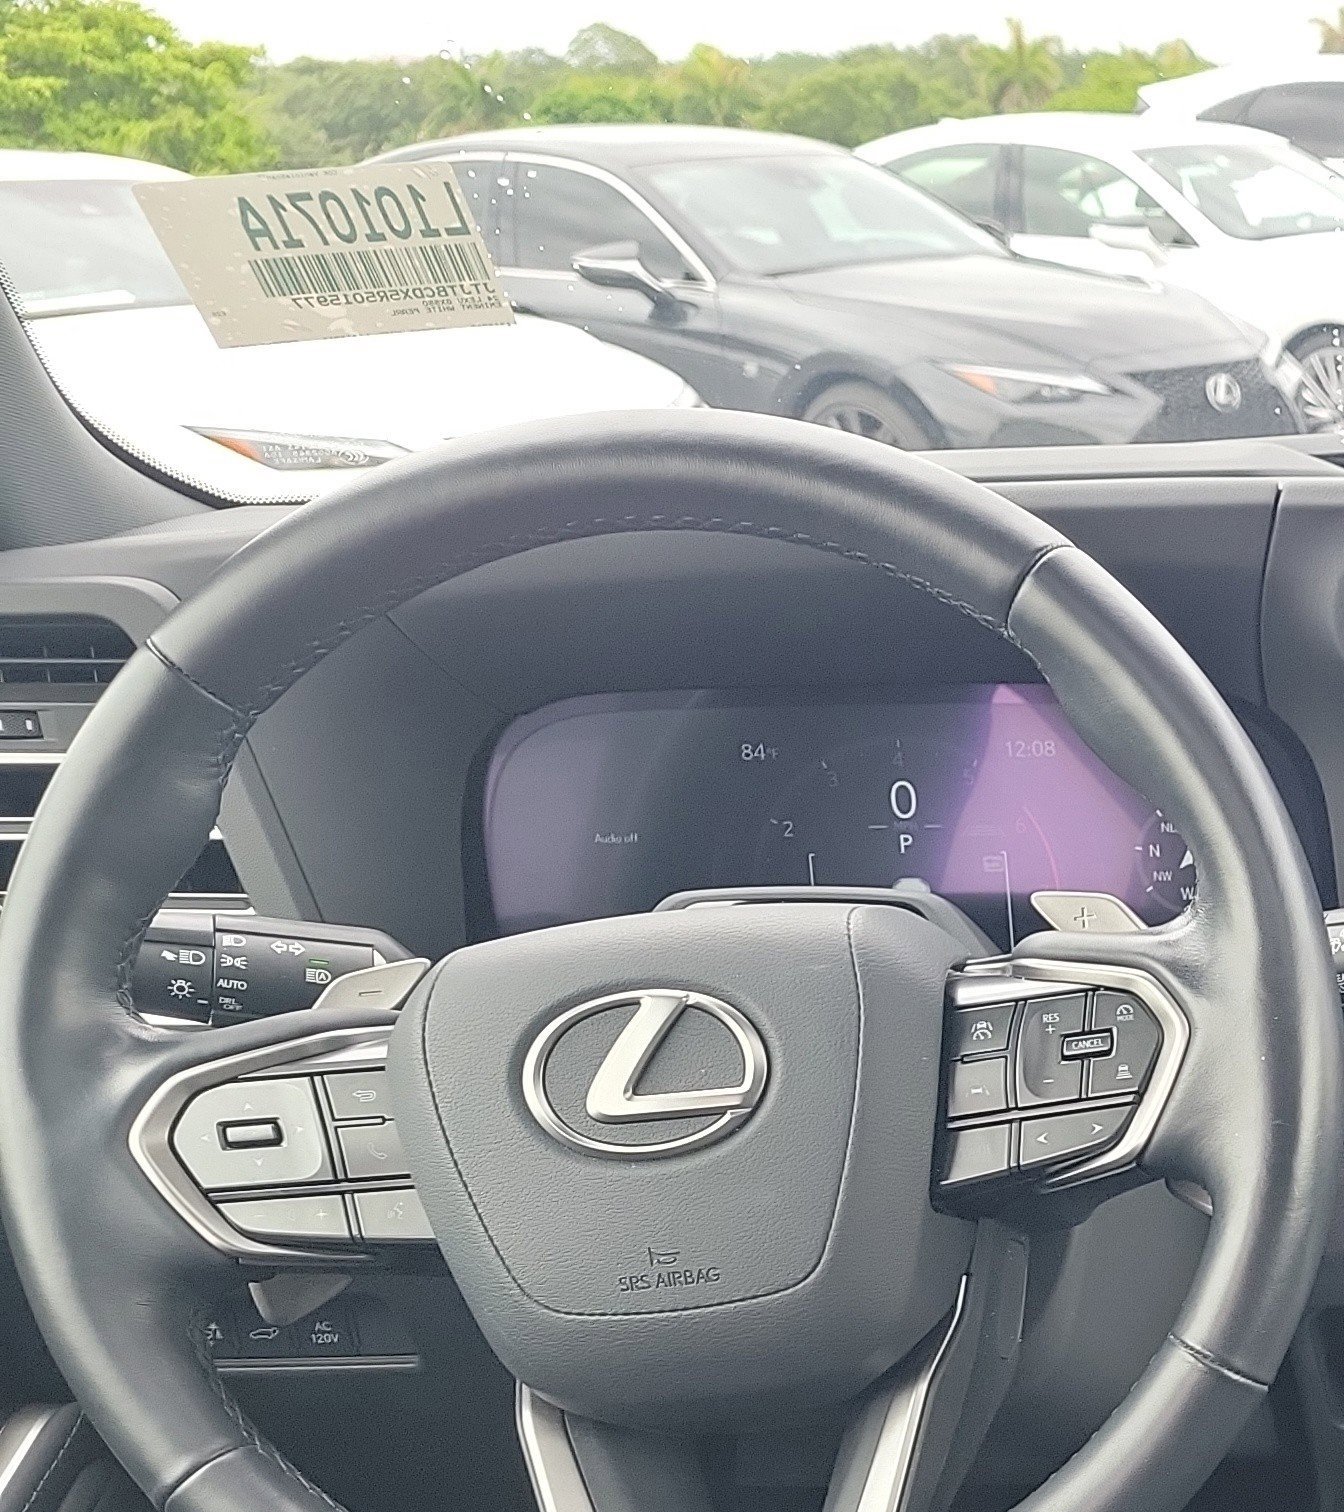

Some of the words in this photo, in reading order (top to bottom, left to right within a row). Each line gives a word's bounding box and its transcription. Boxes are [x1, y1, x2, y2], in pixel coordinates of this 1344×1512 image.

[1005, 740, 1056, 759] 12:08
[890, 780, 917, 820] 0
[783, 821, 794, 838] 2
[900, 834, 913, 854] P
[1149, 844, 1161, 858] N
[1153, 871, 1173, 882] NW
[217, 978, 248, 991] AUTO
[1042, 1012, 1060, 1024] RES
[1071, 1038, 1105, 1050] CANCEL
[618, 1274, 651, 1293] SRS
[655, 1266, 721, 1290] AIRBAG
[314, 1321, 332, 1332] AC
[310, 1333, 339, 1345] 120V
